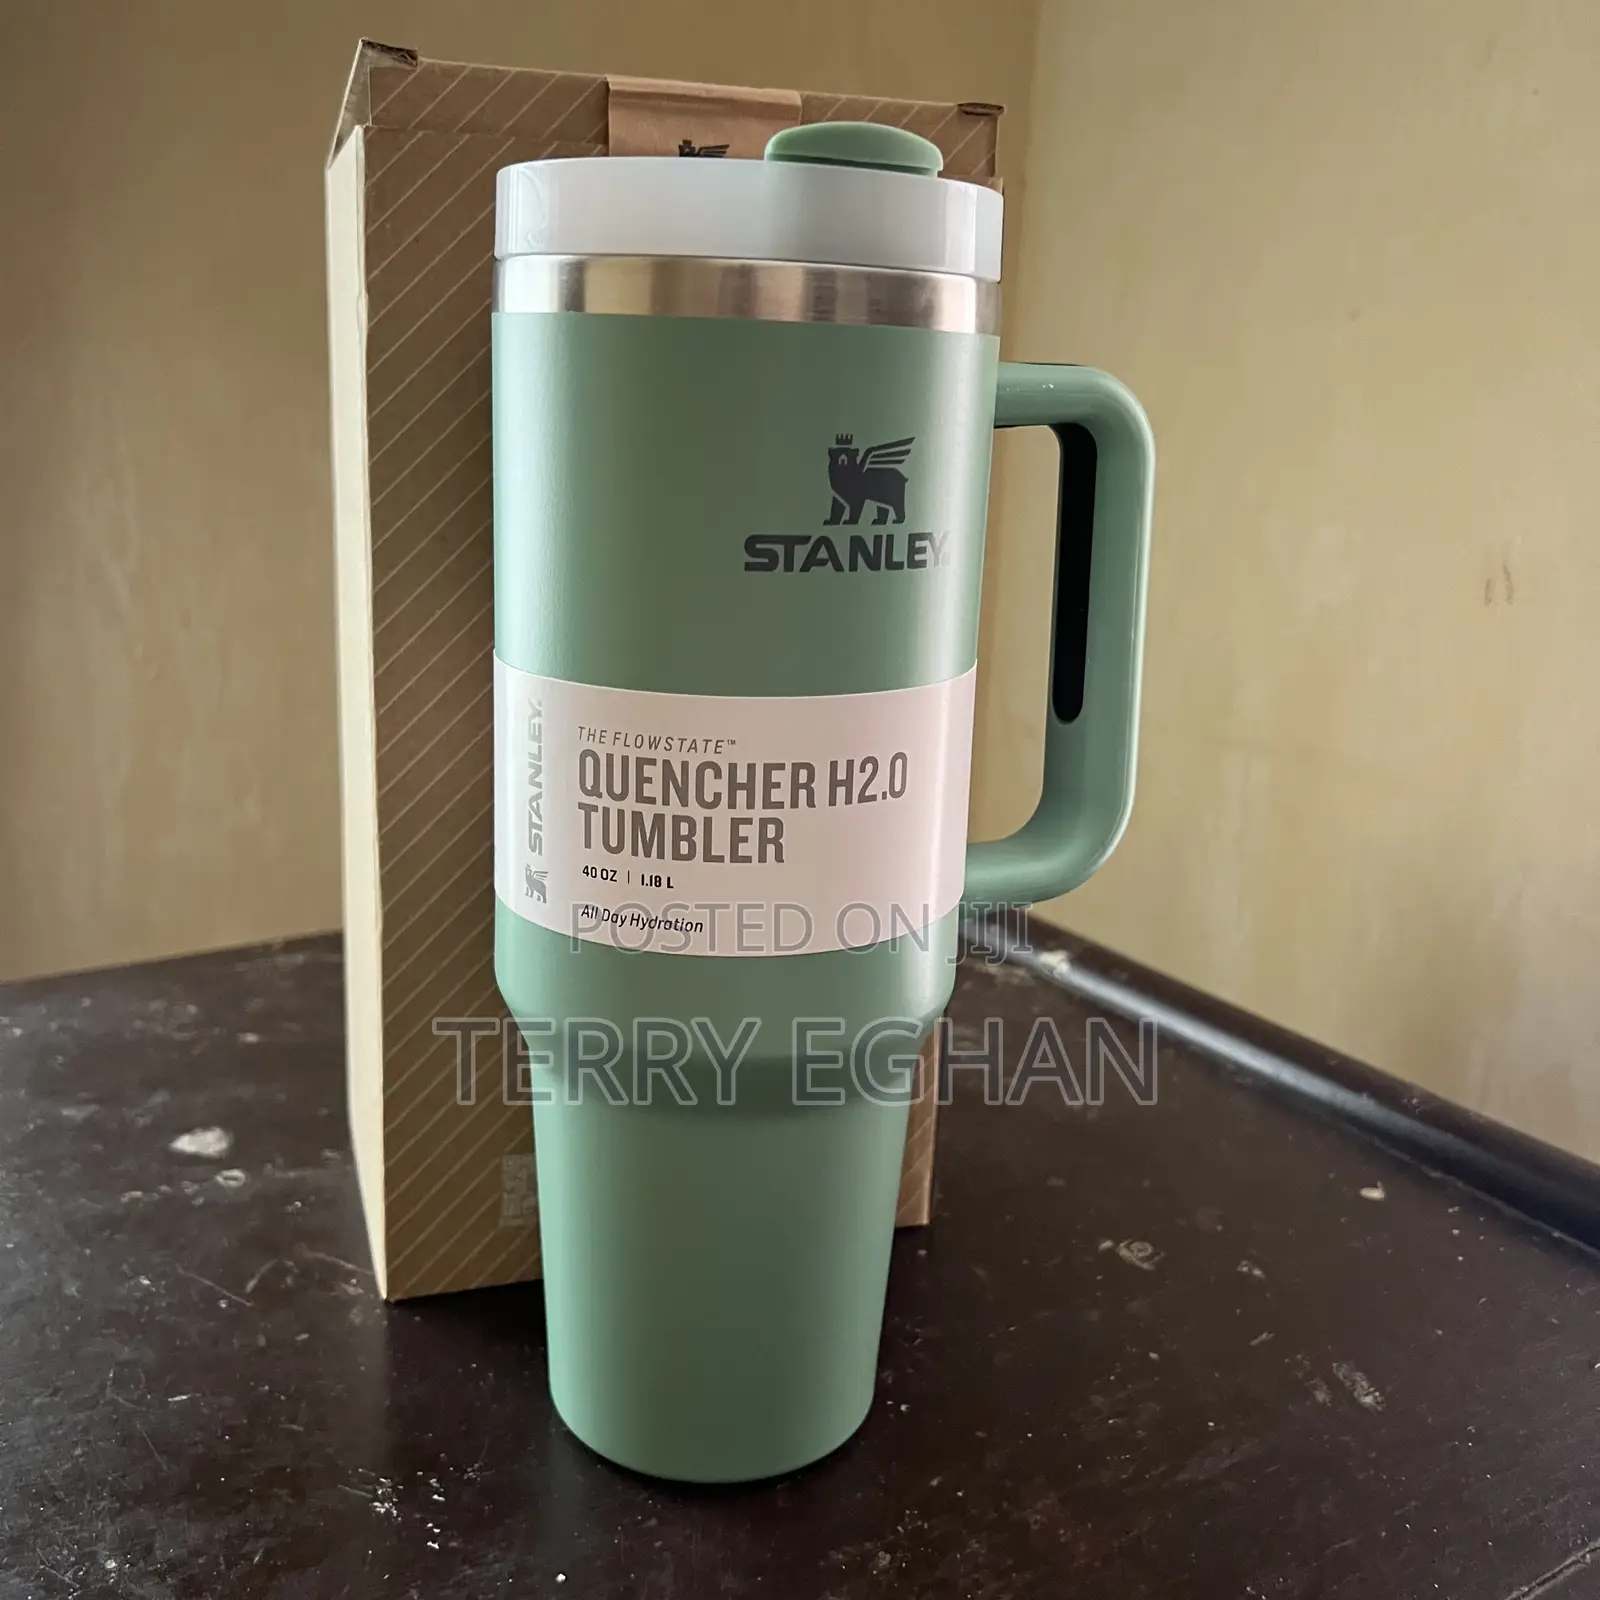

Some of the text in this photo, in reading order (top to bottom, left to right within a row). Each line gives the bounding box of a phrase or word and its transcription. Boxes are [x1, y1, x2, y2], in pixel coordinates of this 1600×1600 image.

[744, 531, 949, 572] STANLEY
[578, 726, 607, 744] THE
[527, 697, 543, 857] STANLEY
[578, 748, 908, 811] QUENCHER H2.0
[577, 802, 785, 864] TUMBLER
[582, 865, 674, 889] 40 OZ 1.18 L
[580, 904, 704, 933] All Day Hydration
